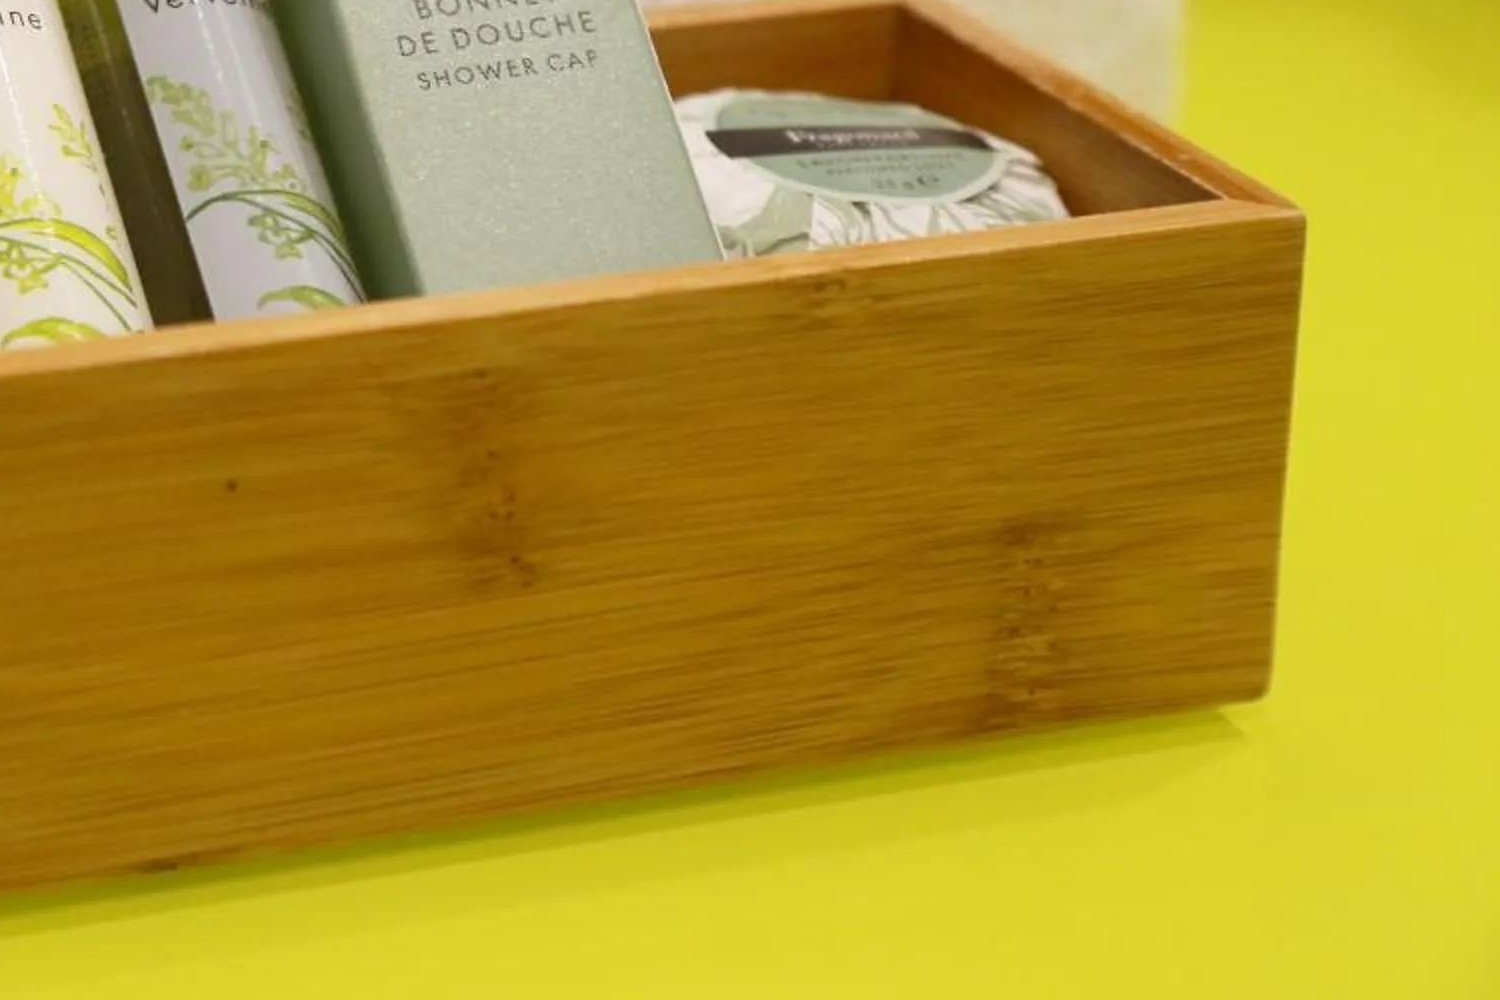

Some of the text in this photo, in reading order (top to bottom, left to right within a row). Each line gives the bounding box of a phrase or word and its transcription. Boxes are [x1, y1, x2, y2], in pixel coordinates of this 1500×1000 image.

[396, 10, 598, 58] DE DOUCHE
[416, 48, 599, 91] SHOWER CAP
